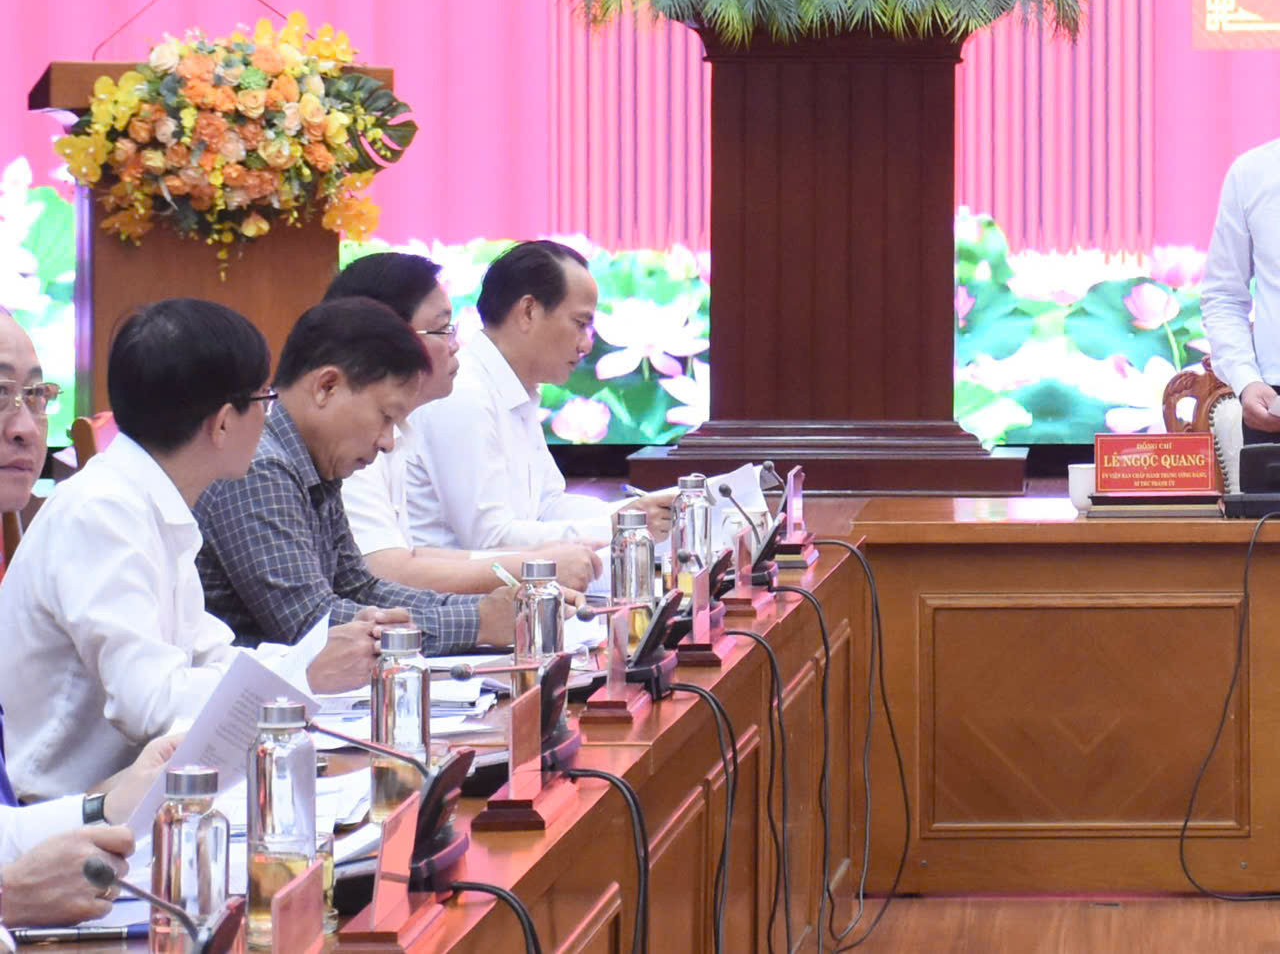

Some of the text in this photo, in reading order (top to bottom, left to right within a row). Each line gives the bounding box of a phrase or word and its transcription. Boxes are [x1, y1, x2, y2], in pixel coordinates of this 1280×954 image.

[1103, 452, 1206, 470] LÊ NGỌC QUANG
